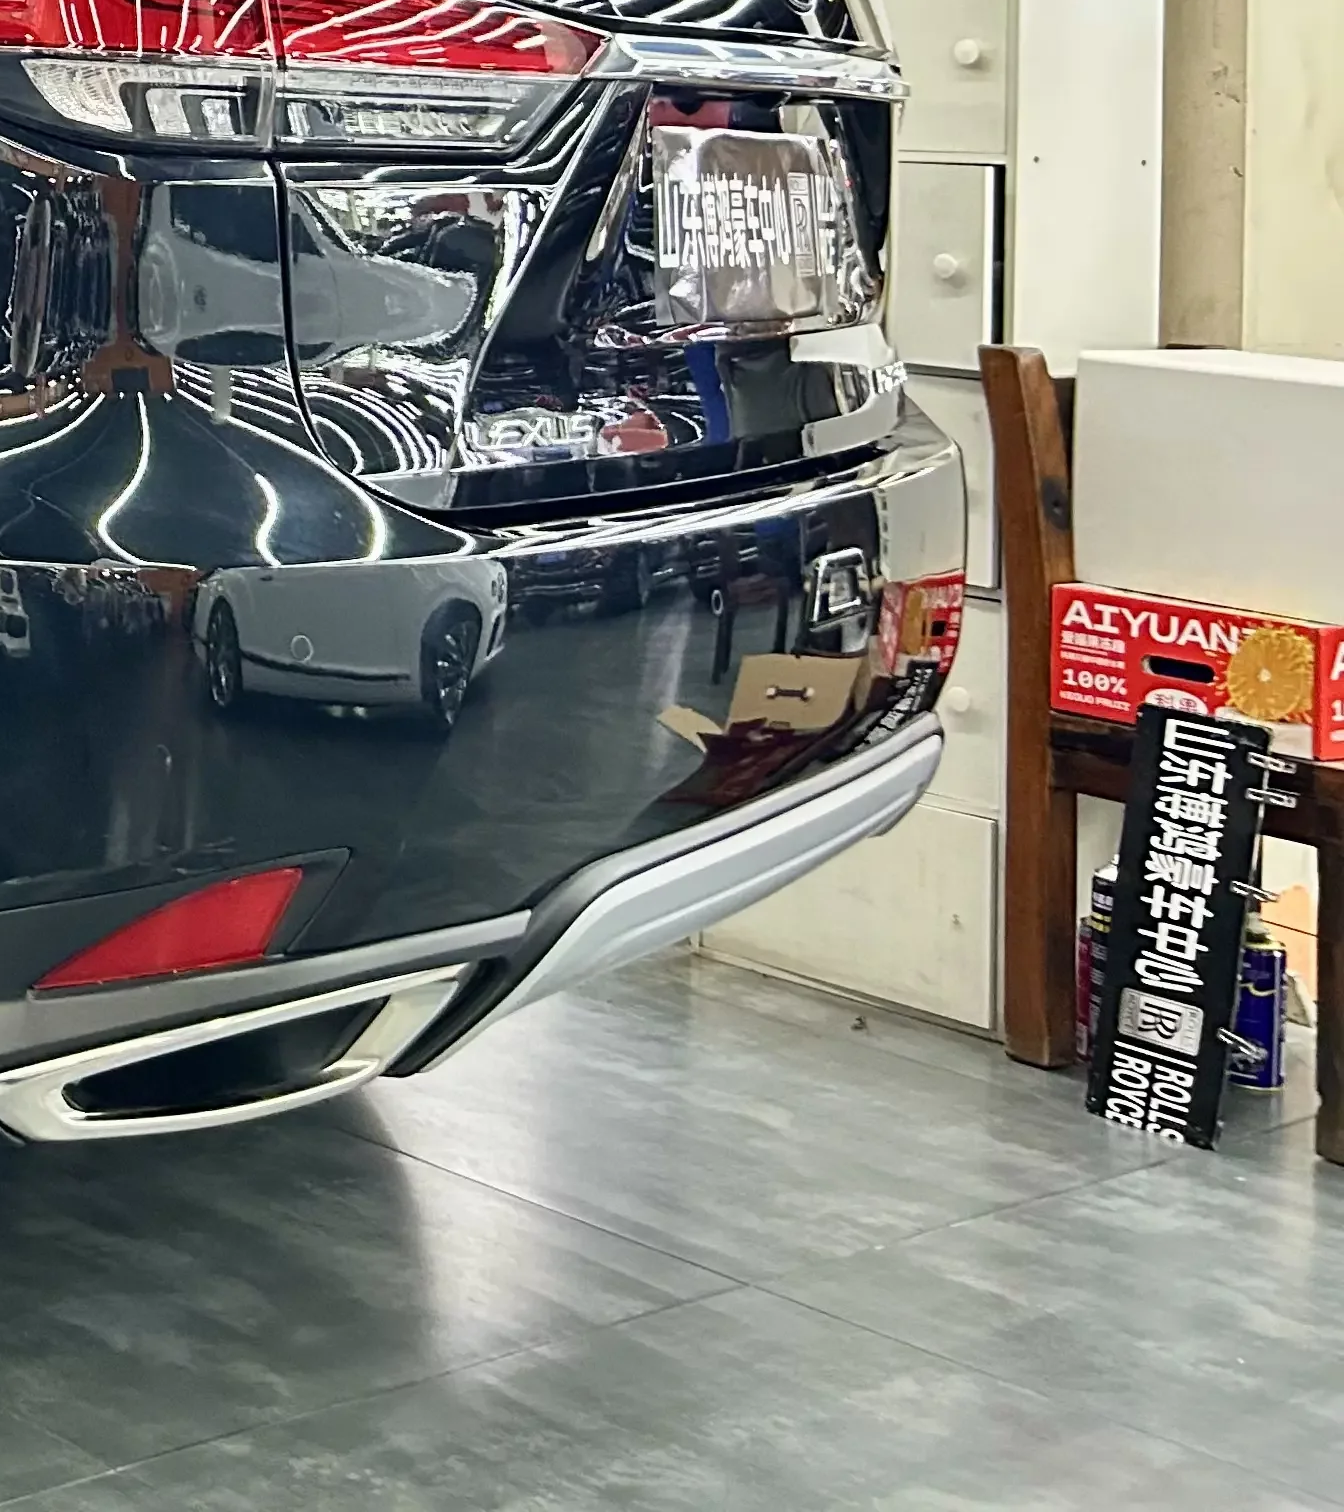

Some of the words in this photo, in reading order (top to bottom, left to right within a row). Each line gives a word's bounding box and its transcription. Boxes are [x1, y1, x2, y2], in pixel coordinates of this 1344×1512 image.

[463, 414, 594, 452] LEXUS
[1062, 599, 1256, 655] AIYUAN
[1062, 668, 1128, 696] 100%
[1134, 717, 1236, 993] 山东博鸿豪车中心
